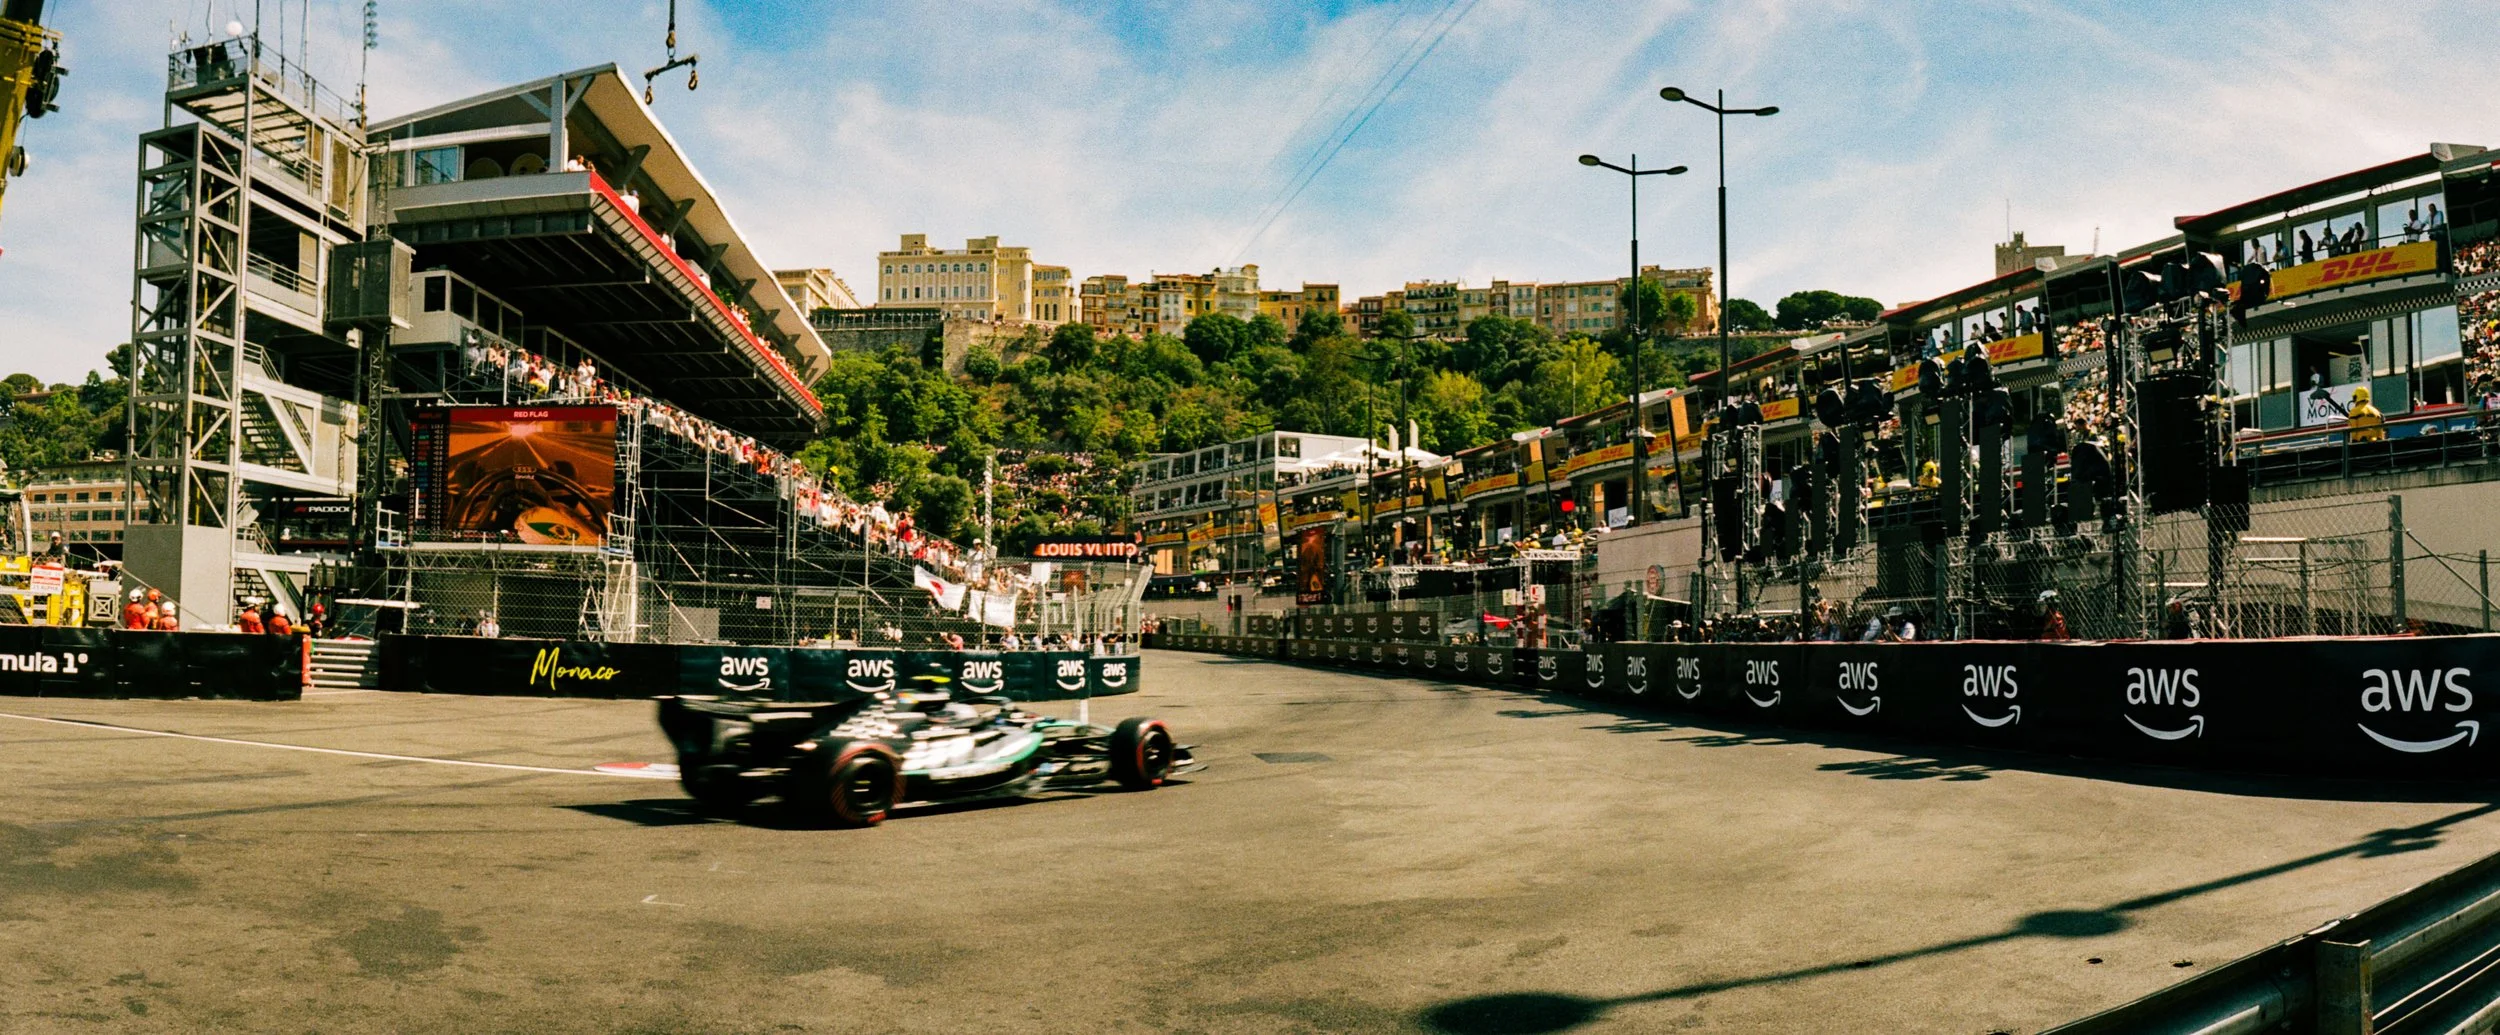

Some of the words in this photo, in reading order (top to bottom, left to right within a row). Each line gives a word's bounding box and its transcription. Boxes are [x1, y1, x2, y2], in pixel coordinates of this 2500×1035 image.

[2322, 252, 2400, 281] DHL
[513, 410, 529, 418] RED
[529, 410, 549, 418] FLAG
[1040, 543, 1083, 556] LOUIS
[530, 646, 621, 691] Monaco
[720, 656, 769, 677] aws
[848, 658, 895, 678] aws
[1057, 659, 1085, 678] aws
[1487, 653, 1503, 665] aws
[1538, 656, 1557, 670] aws
[1586, 654, 1604, 673] aws
[1627, 655, 1647, 677] aws
[1677, 657, 1700, 681] aws
[961, 660, 1003, 680] aws
[1102, 662, 1127, 678] aws
[1746, 659, 1779, 686] aws
[1838, 661, 1878, 692] aws
[1963, 664, 2018, 699] aws
[2126, 667, 2200, 708] aws
[2361, 667, 2473, 712] aws
